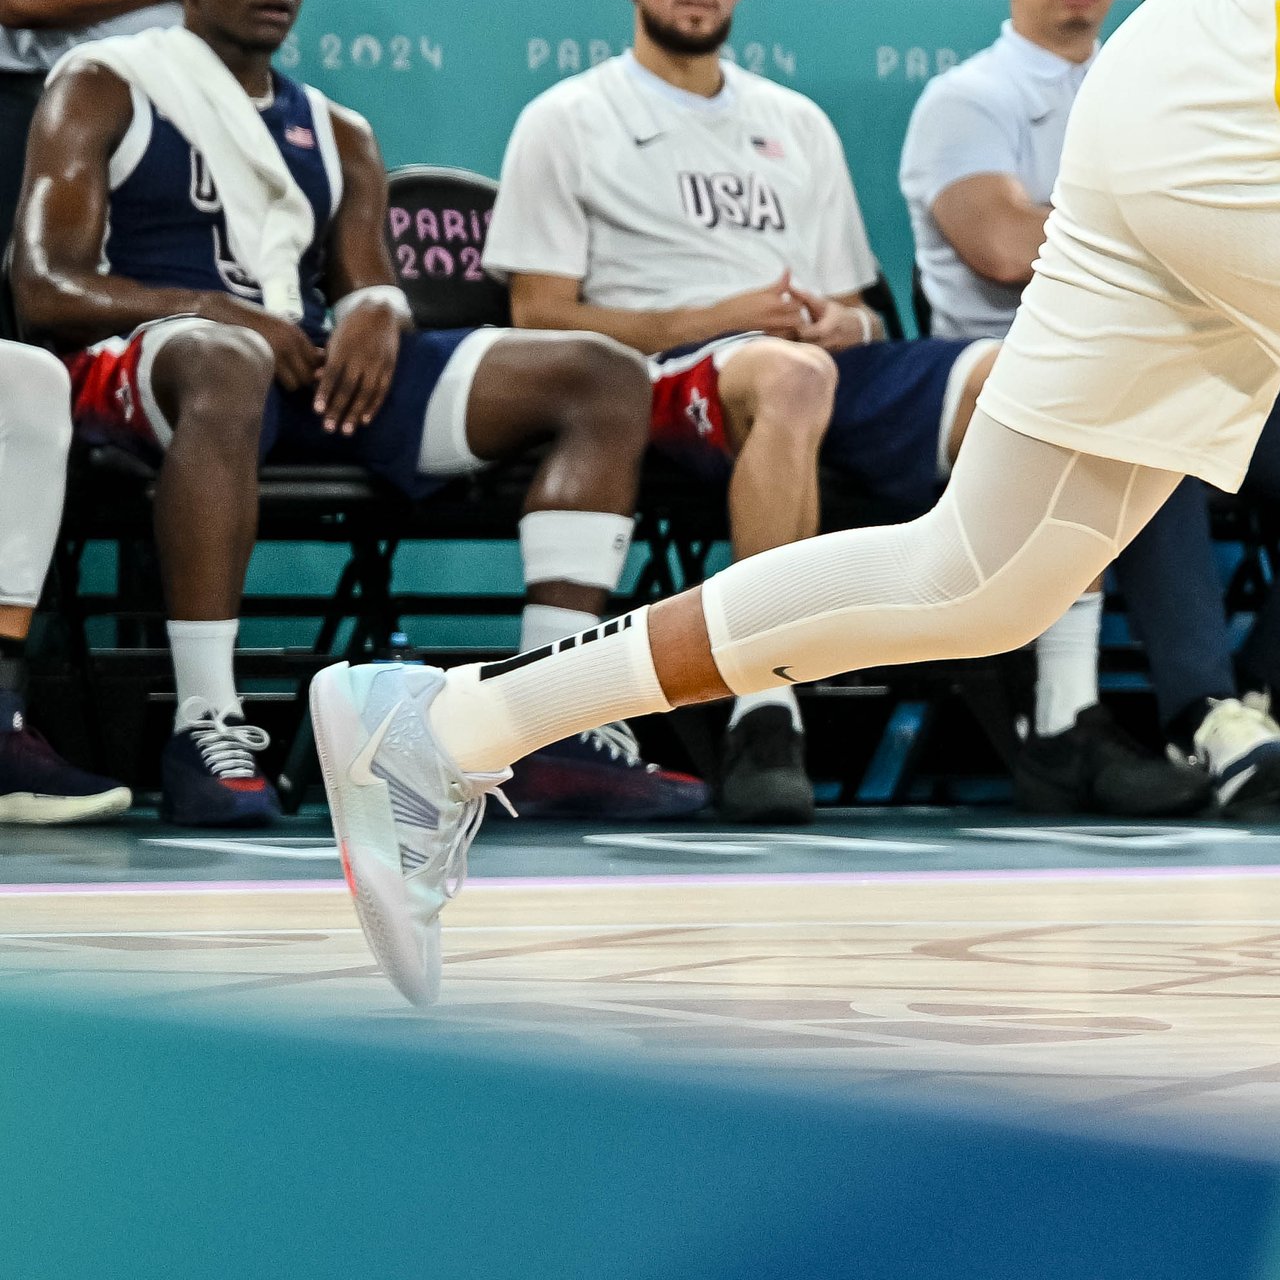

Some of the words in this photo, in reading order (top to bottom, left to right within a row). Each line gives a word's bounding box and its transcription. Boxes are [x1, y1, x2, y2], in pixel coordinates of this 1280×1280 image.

[320, 32, 443, 70] 2024
[526, 37, 614, 72] PAR
[723, 40, 797, 76] 24
[876, 44, 959, 81] PAR
[679, 170, 785, 230] USA
[396, 243, 484, 280] 202
